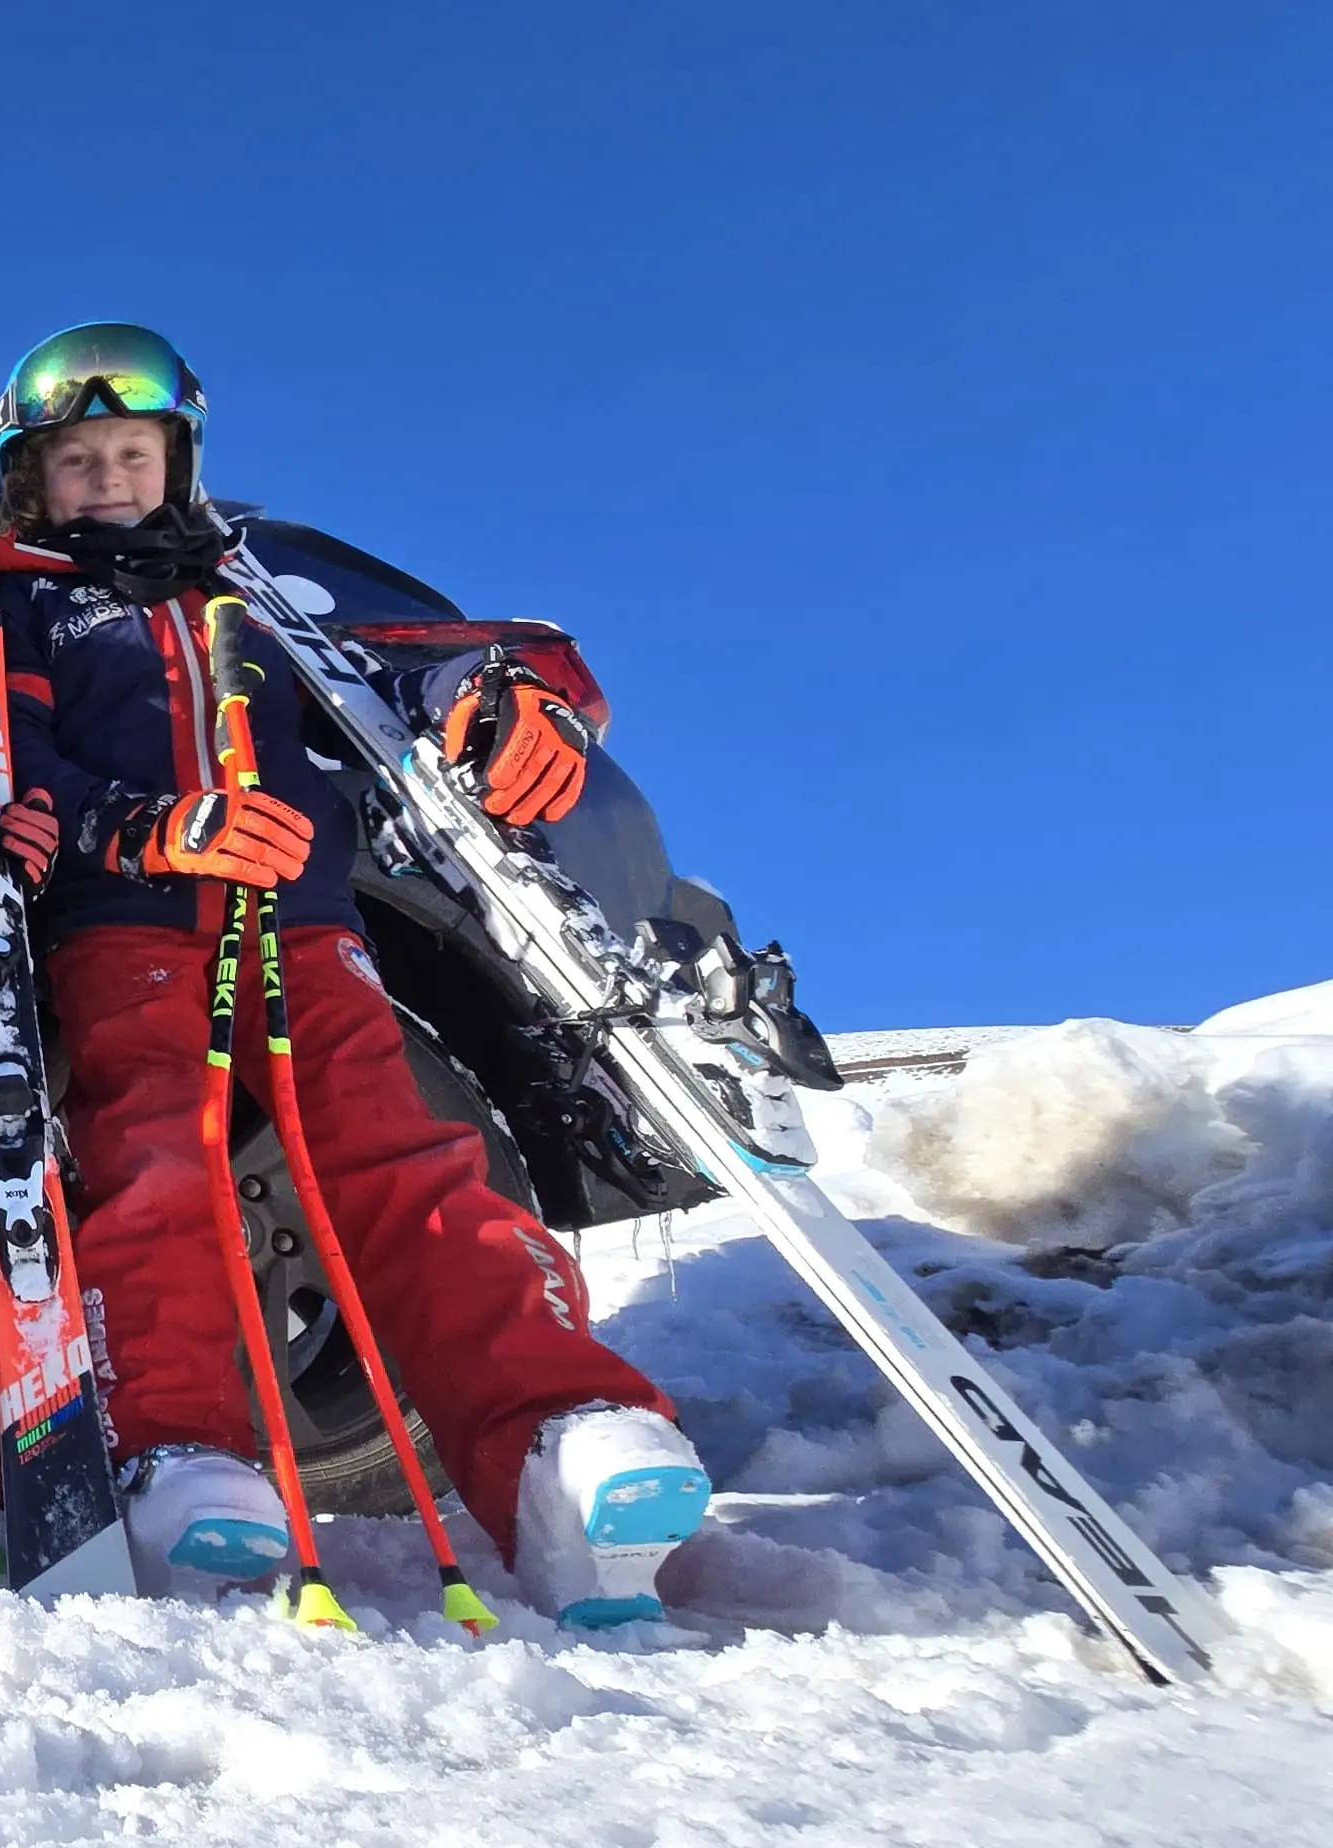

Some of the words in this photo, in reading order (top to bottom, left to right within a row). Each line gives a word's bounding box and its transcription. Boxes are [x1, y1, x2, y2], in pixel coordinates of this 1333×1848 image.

[68, 602, 123, 639] MEDS
[226, 555, 367, 687] HEA
[212, 933, 240, 1018] LEKI
[257, 904, 282, 1000] LEKI
[0, 1334, 94, 1433] HERO
[949, 1375, 1213, 1671] HEAD
